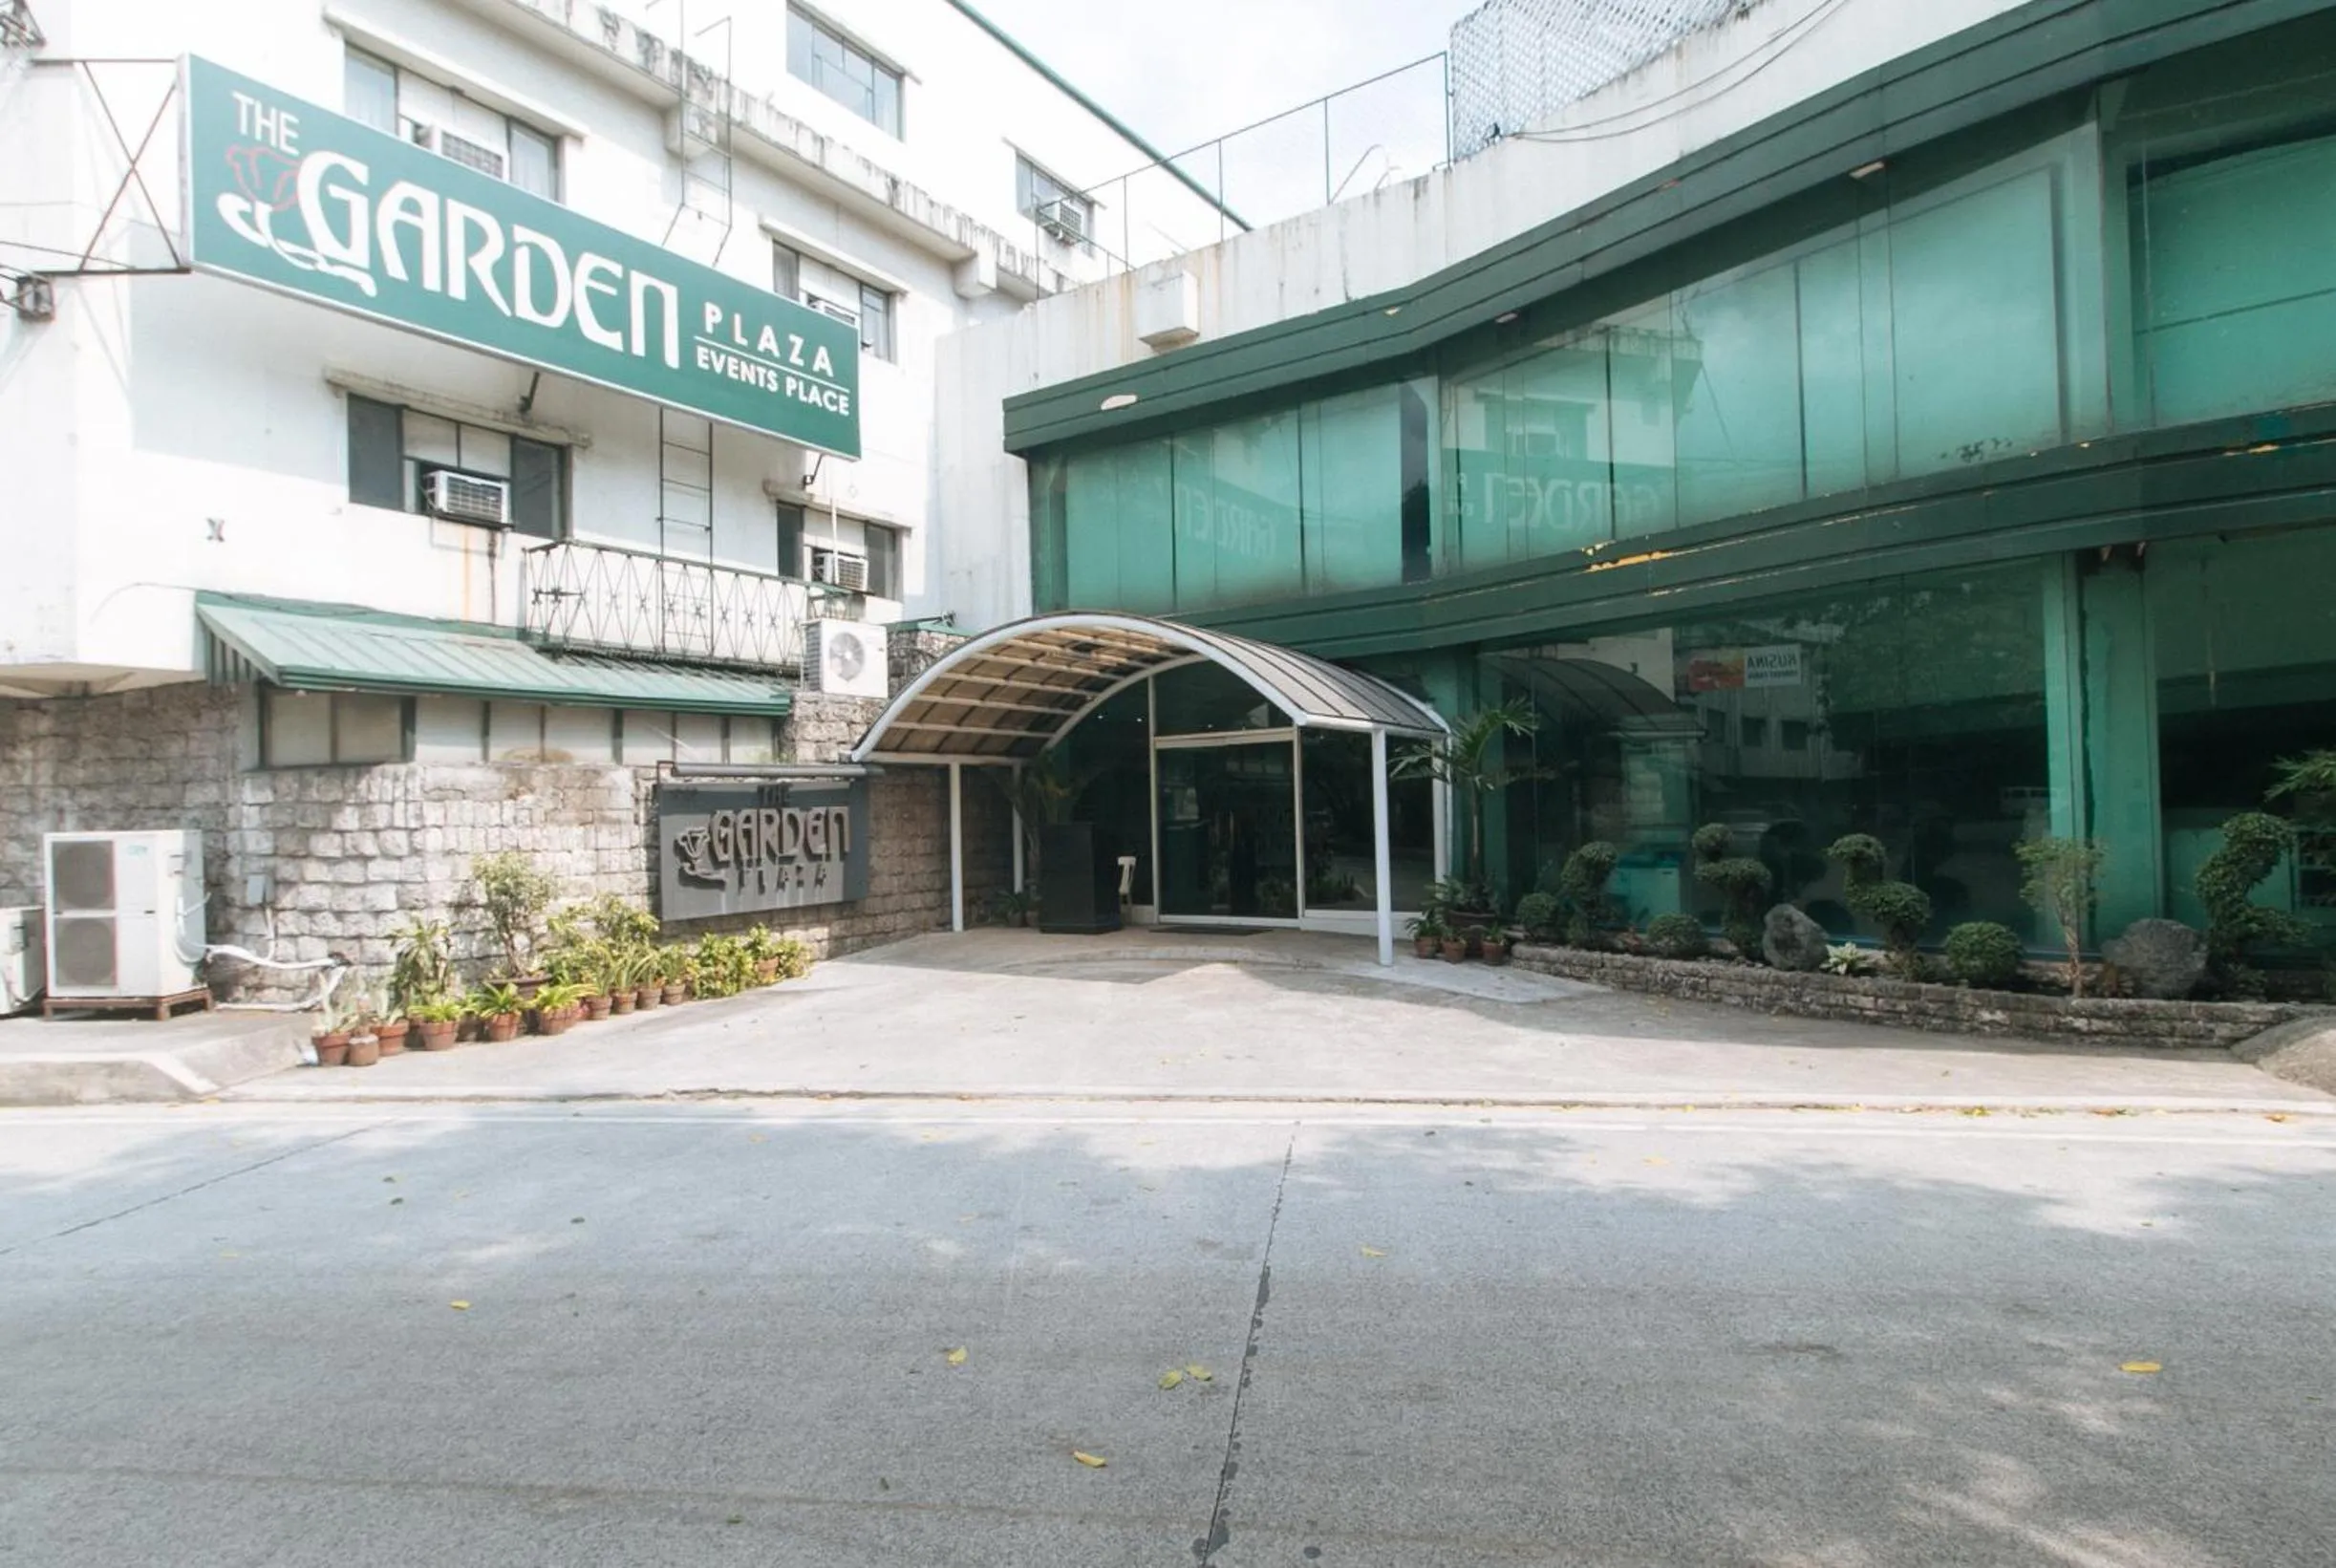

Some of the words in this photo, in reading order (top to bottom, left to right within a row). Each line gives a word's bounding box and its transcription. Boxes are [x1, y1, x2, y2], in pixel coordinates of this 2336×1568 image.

[232, 91, 300, 156] THE
[296, 150, 679, 370] GARDEN
[704, 301, 834, 377] PLAZA
[696, 345, 779, 393] EVENTS
[785, 376, 849, 416] PLACE
[709, 805, 849, 864] GARDEN
